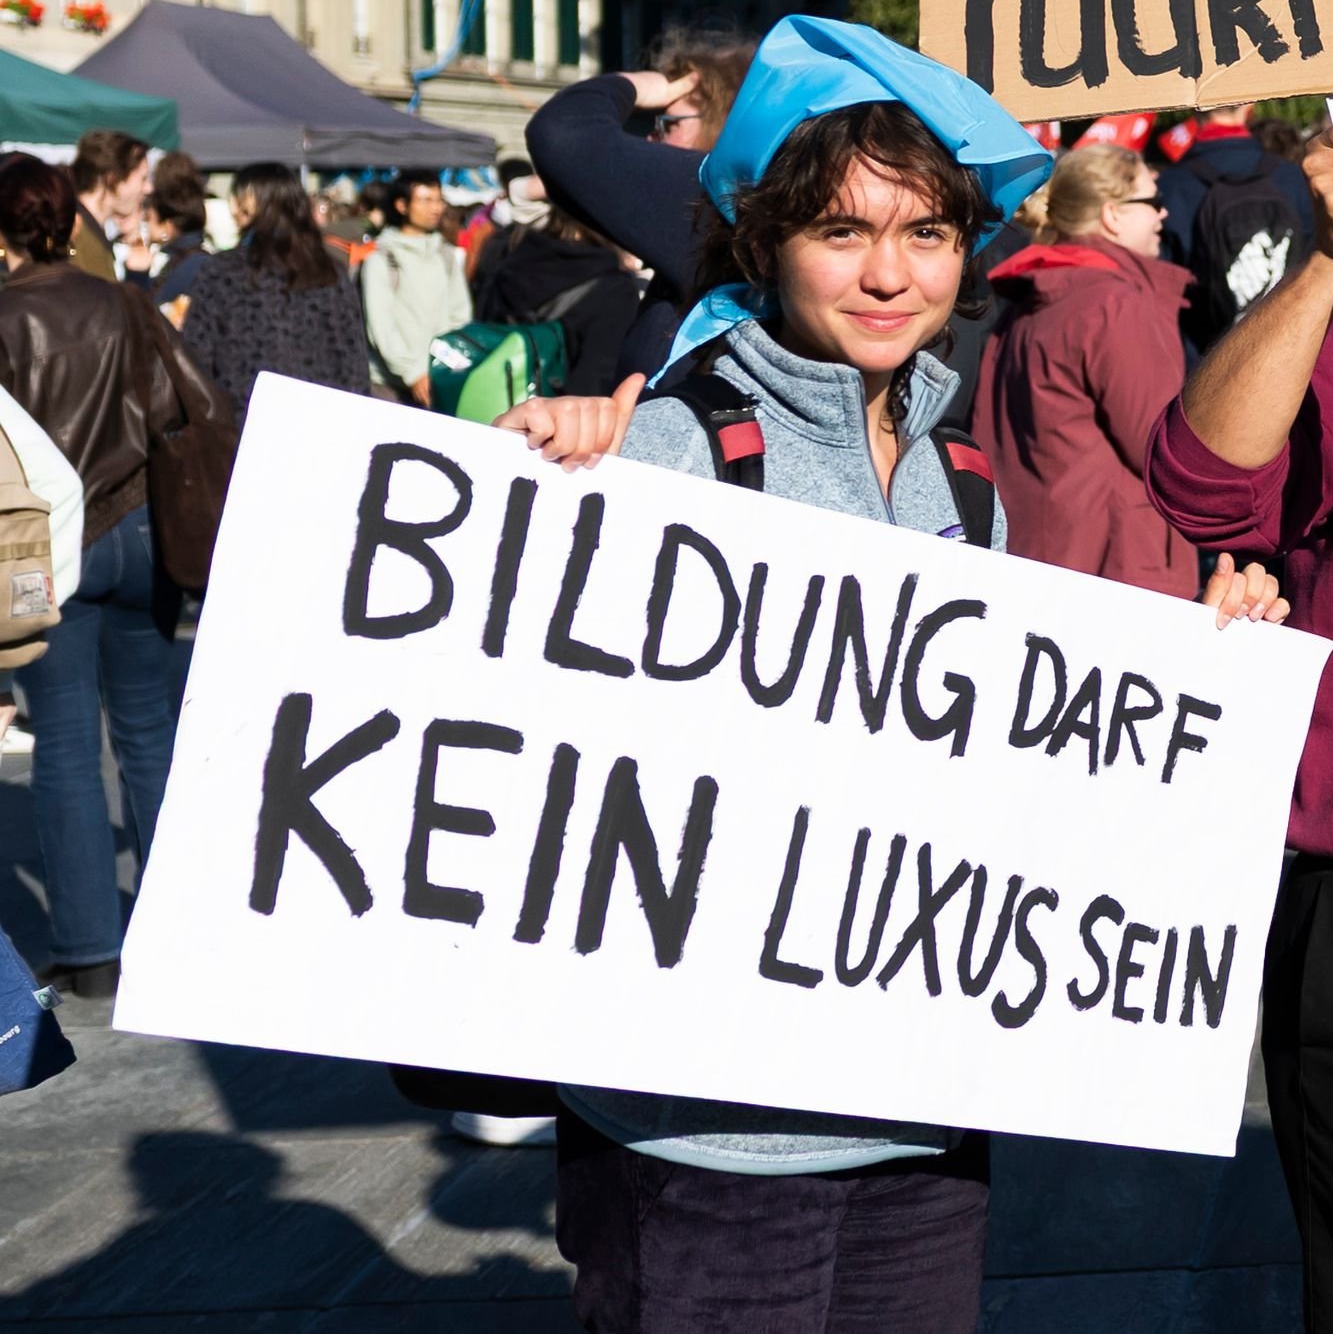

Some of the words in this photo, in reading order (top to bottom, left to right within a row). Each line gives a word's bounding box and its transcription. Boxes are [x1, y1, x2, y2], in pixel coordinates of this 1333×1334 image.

[341, 441, 988, 758] BILDUNG
[1007, 632, 1222, 785] DARF
[247, 691, 720, 969] KEIN
[758, 803, 1059, 1030] LUXUS
[1066, 893, 1237, 1029] SEIN
